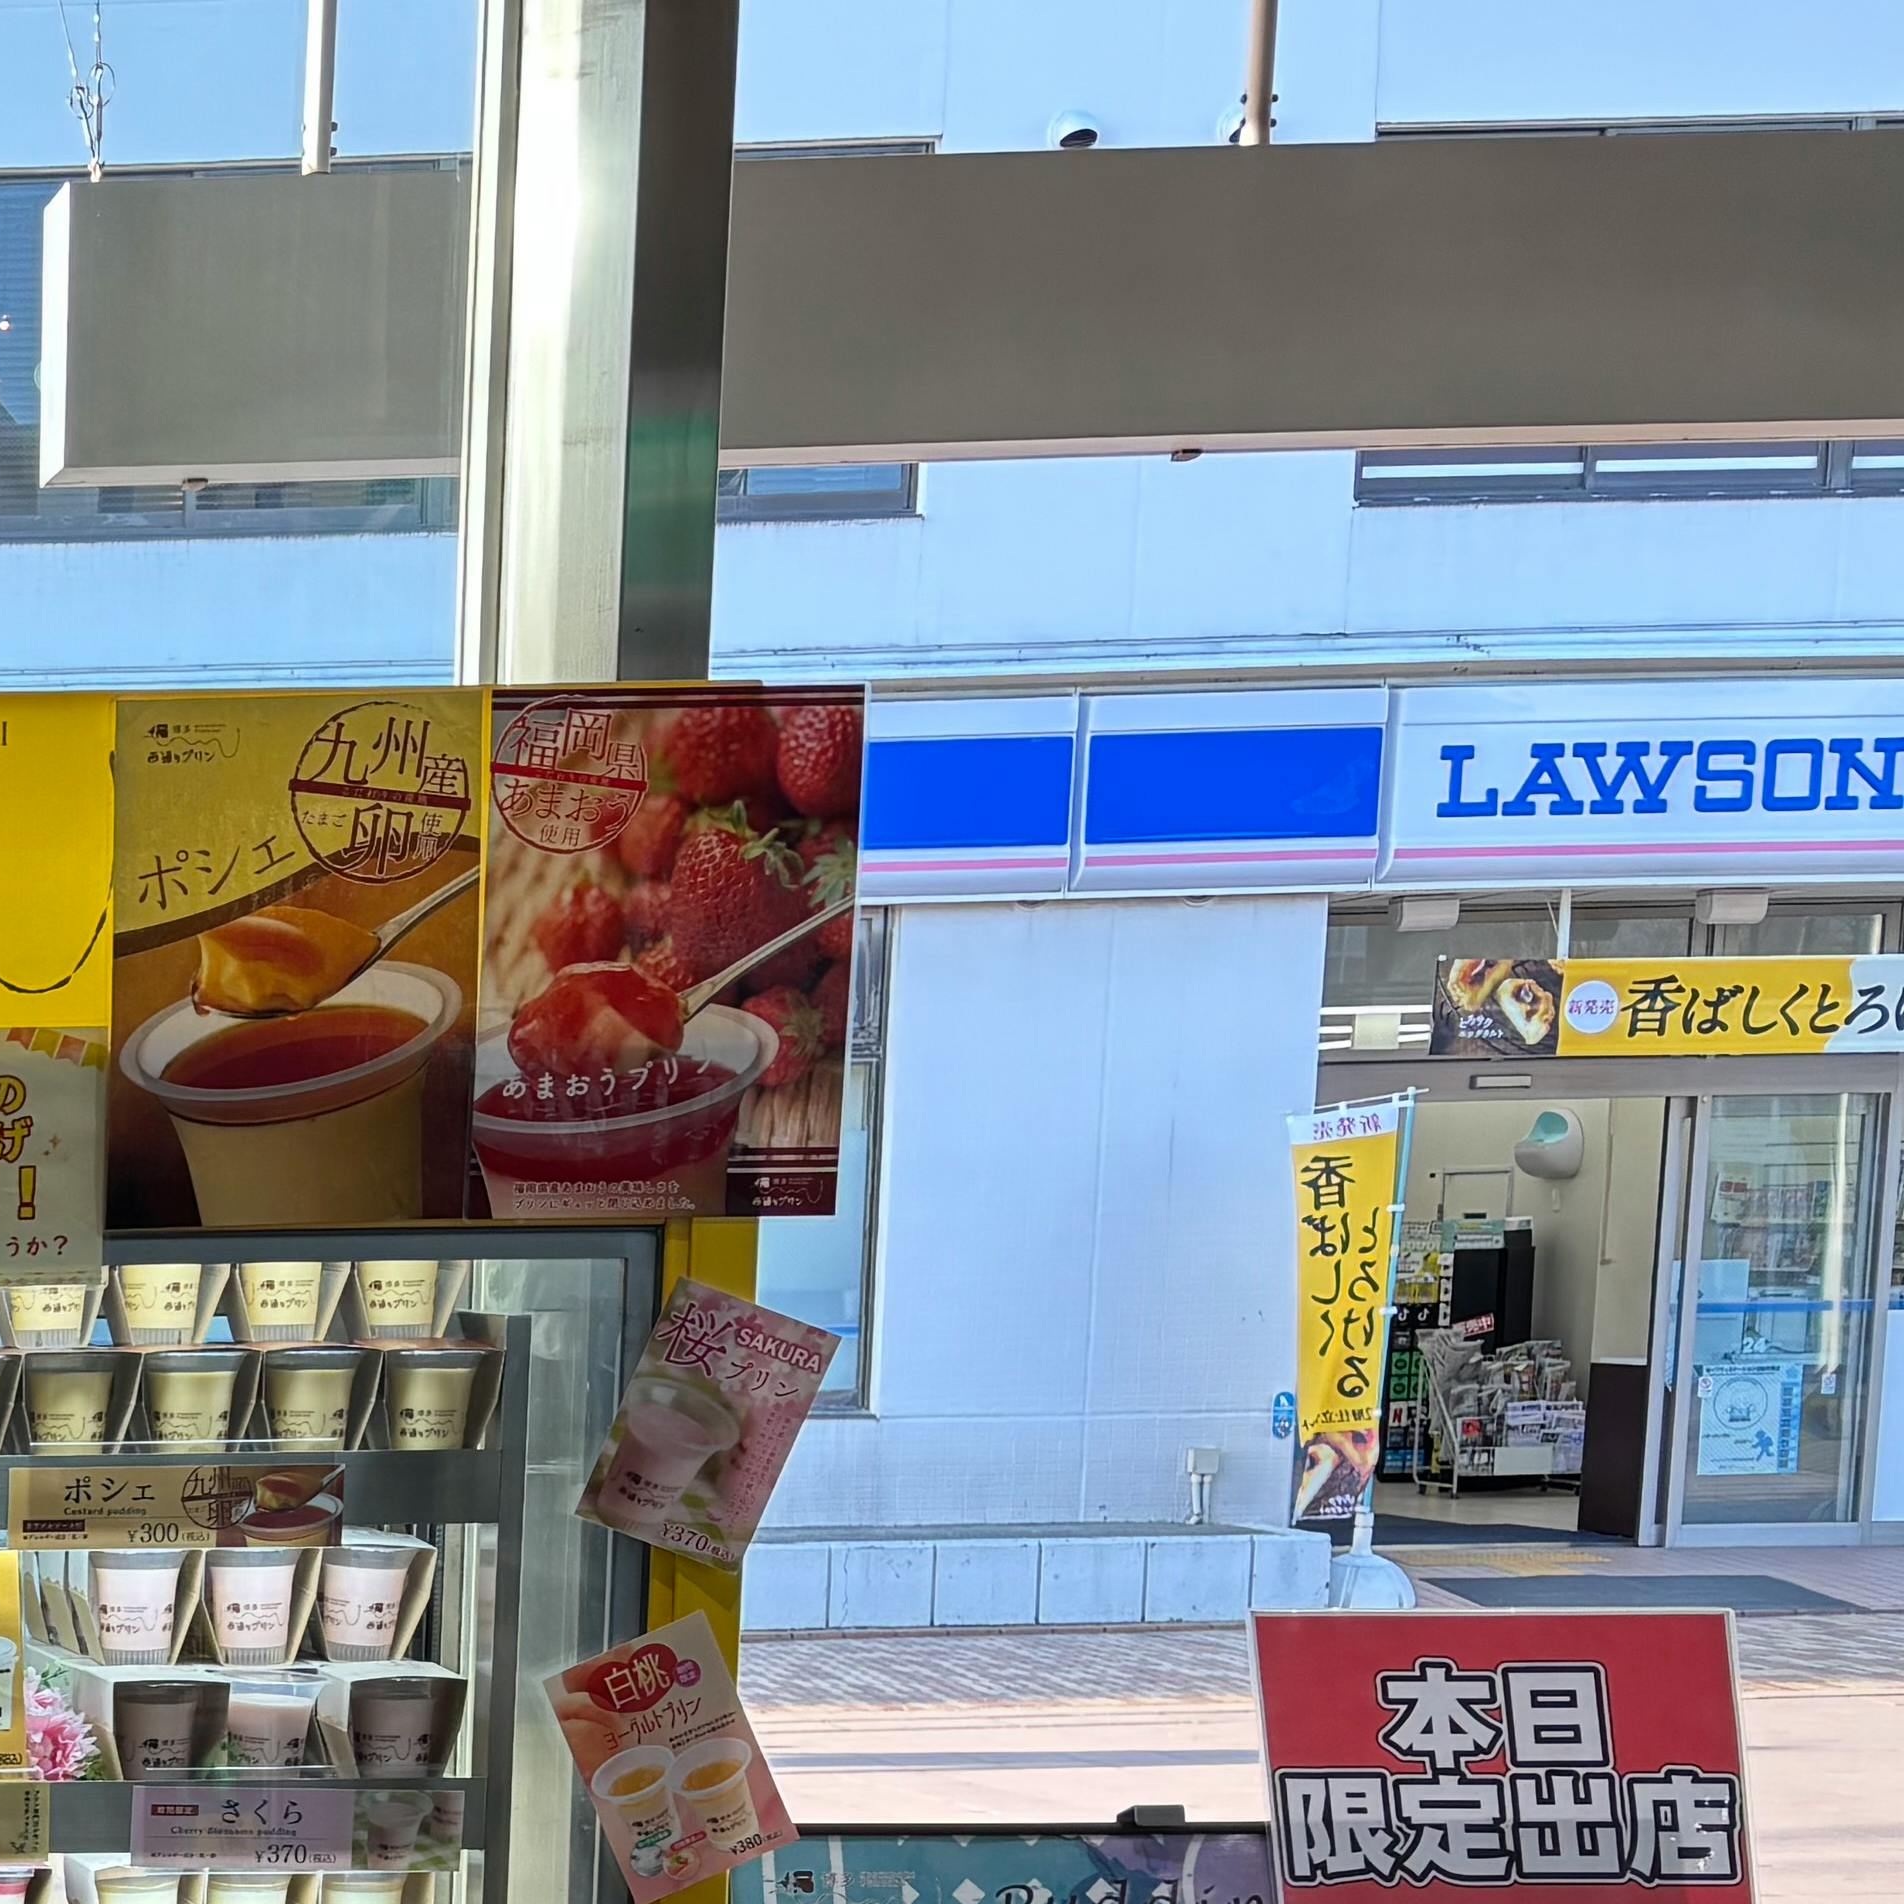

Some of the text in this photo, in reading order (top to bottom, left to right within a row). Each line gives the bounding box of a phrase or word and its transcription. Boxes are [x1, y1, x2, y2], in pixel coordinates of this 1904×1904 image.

[312, 716, 468, 795] 九州産
[511, 708, 642, 780] 福岡県
[1435, 737, 1904, 818] LAWSON
[344, 801, 415, 874] 卵
[500, 777, 633, 832] あまおう
[136, 833, 297, 911] ポシェ
[656, 1298, 823, 1378] 桜 SAKURA
[61, 1473, 158, 1505] ポシェ
[603, 1651, 671, 1711] 白桃
[1376, 1657, 1614, 1772] 本日
[219, 1797, 307, 1827] さくら
[1274, 1766, 1745, 1887] 限定出店
